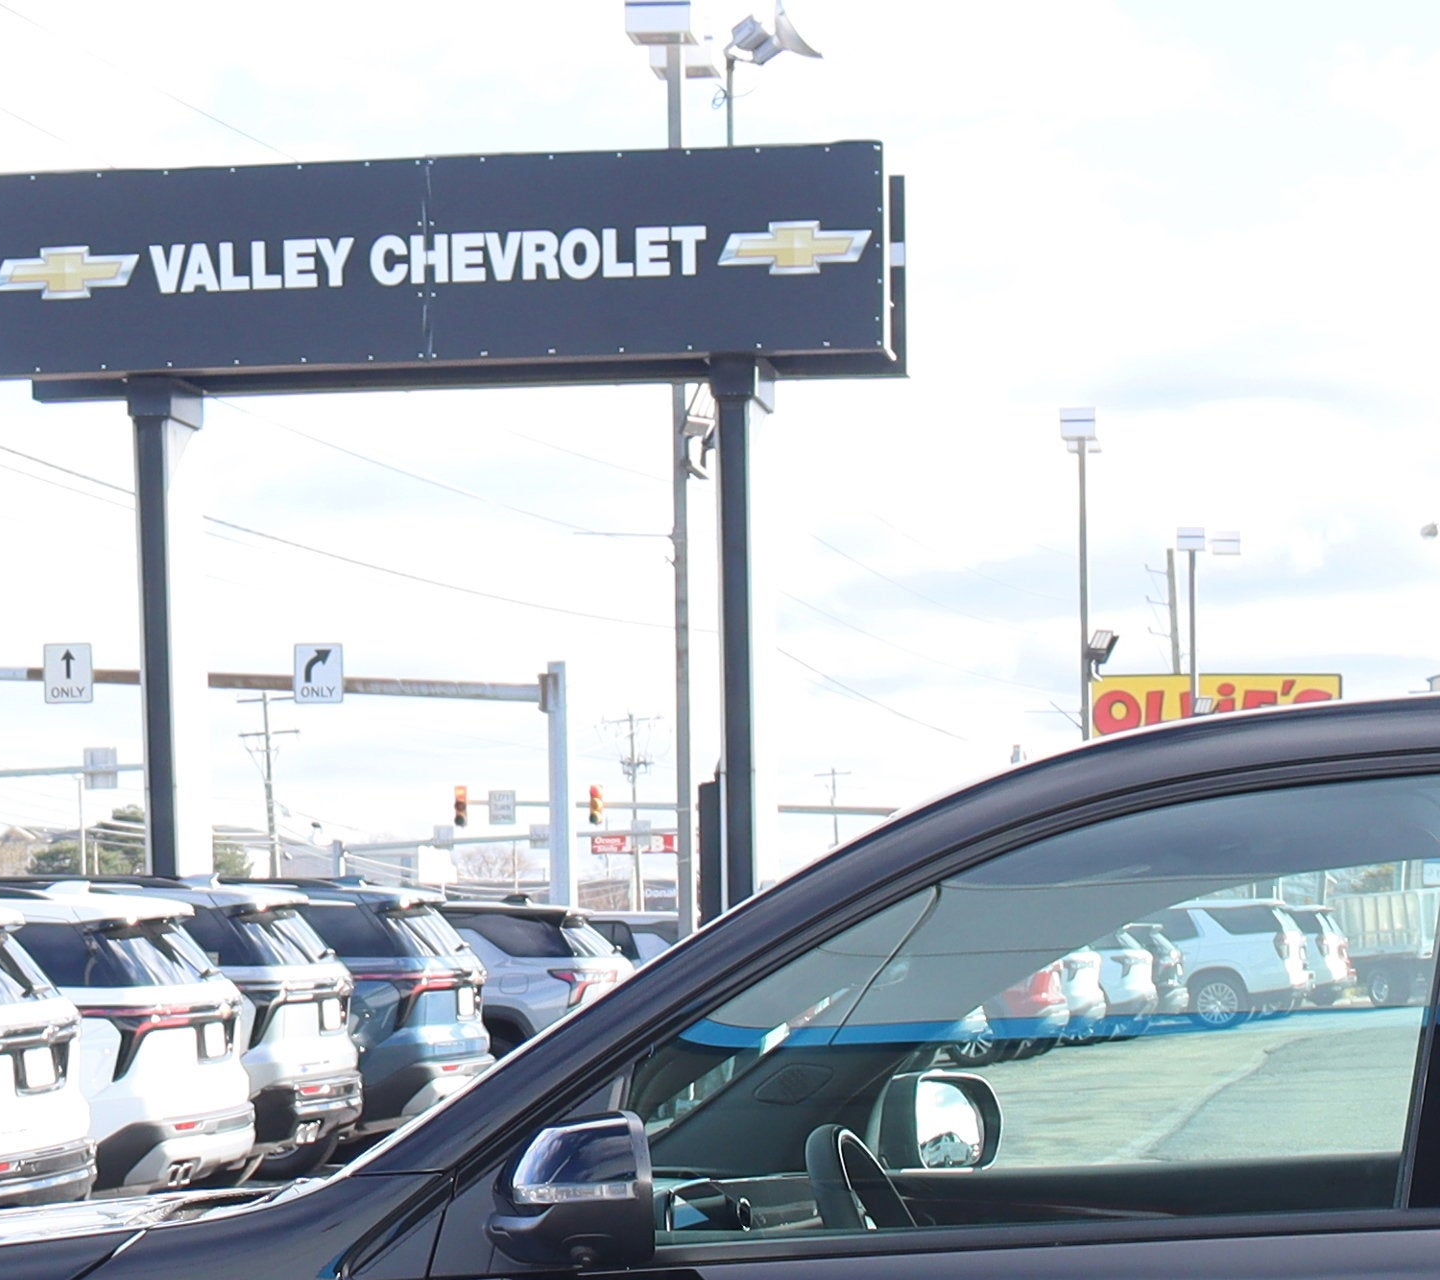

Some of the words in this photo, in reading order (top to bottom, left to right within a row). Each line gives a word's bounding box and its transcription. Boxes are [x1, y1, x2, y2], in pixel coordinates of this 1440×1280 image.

[149, 236, 355, 294] VALLEY
[369, 225, 707, 287] CHEVROLET
[50, 686, 86, 698] ONLY
[300, 686, 337, 698] ONLY
